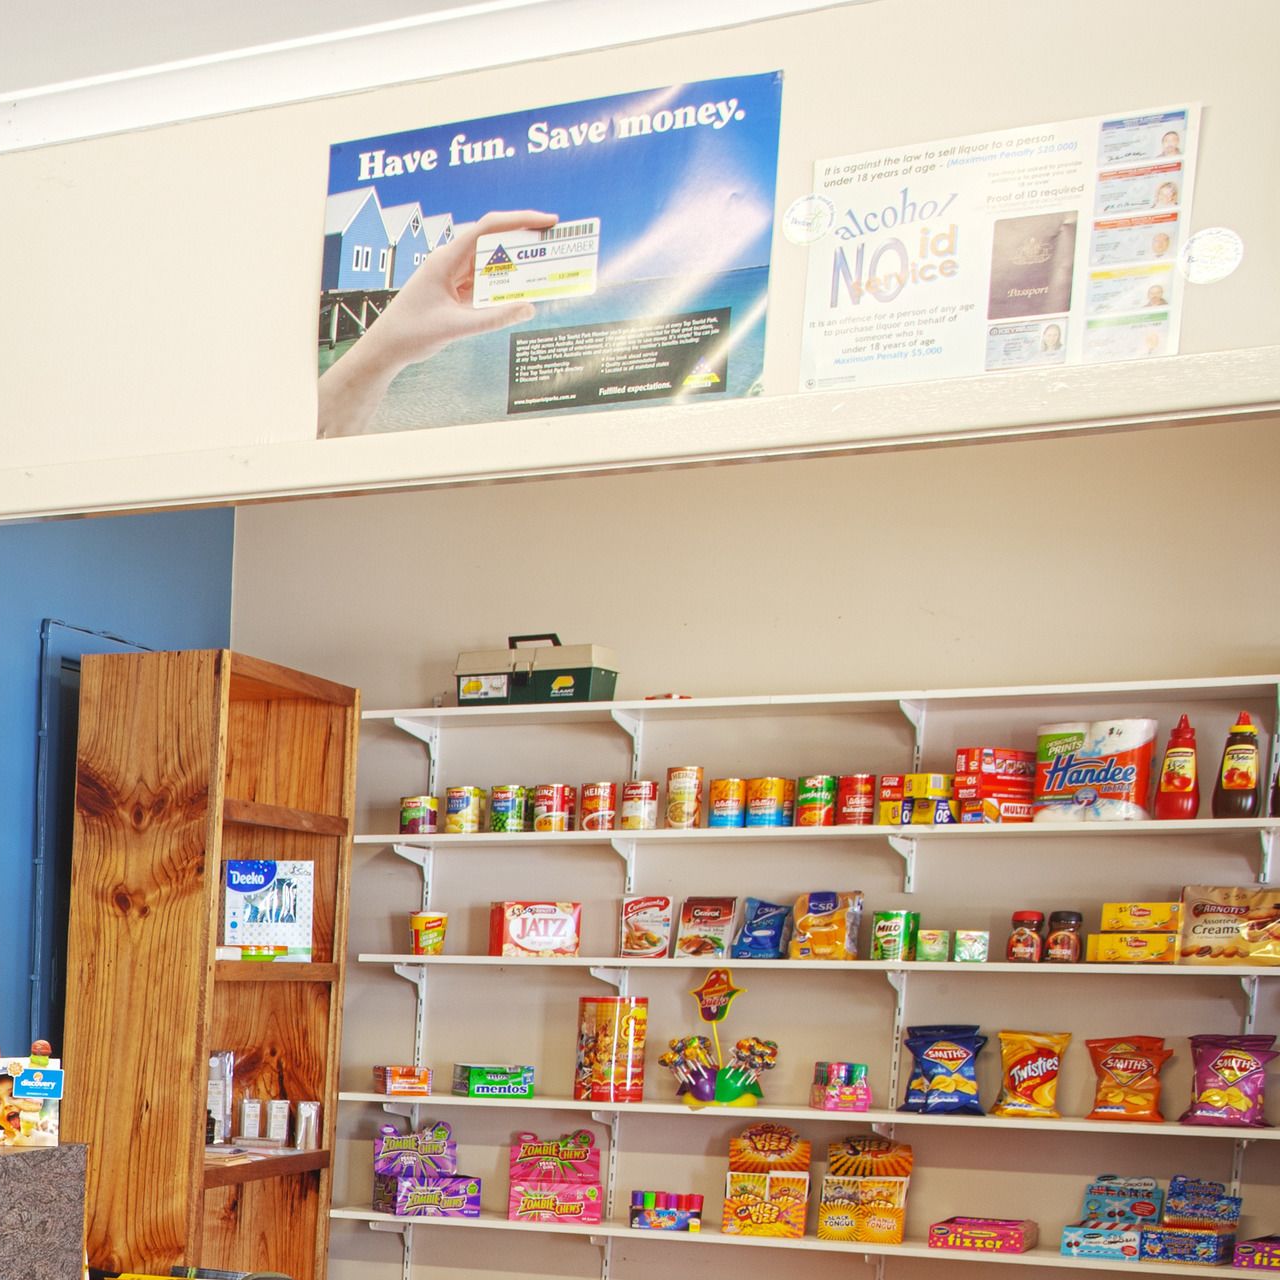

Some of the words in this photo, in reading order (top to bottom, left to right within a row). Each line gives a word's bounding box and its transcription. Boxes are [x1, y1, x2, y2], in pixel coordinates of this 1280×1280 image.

[359, 146, 438, 180] Have
[449, 136, 515, 166] fun.
[527, 116, 605, 154] Save
[616, 98, 745, 138] money.
[843, 161, 881, 175] against
[884, 156, 901, 167] the
[903, 152, 921, 163] law
[924, 150, 935, 160] to
[938, 146, 955, 158] sell
[958, 141, 989, 157] liquor
[992, 139, 1002, 149] to
[1017, 132, 1055, 147] person
[824, 175, 853, 188] under
[857, 173, 868, 183] 18
[870, 169, 898, 185] years
[902, 166, 913, 176] of
[915, 162, 936, 176] age
[947, 153, 995, 168] (Maximum
[987, 191, 1011, 203] Proof
[1027, 190, 1038, 198] ID
[1040, 184, 1084, 197] required
[834, 187, 959, 241] alcohol
[517, 248, 546, 259] CLUB
[551, 240, 594, 255] MEMBER
[920, 223, 958, 260] id
[830, 237, 909, 308] NO
[852, 258, 959, 297] service
[839, 314, 871, 325] offence
[874, 312, 887, 321] for
[897, 309, 926, 323] person
[929, 306, 938, 314] of
[940, 305, 956, 313] any
[959, 303, 975, 312] age
[835, 324, 874, 339] purchase
[876, 321, 900, 332] liquor
[917, 315, 945, 325] behalf
[948, 314, 957, 322] of
[855, 333, 893, 343] someone
[895, 330, 914, 338] who
[841, 344, 867, 354] under
[870, 343, 880, 351] 18
[882, 341, 906, 351] years
[908, 339, 917, 347] of
[919, 338, 935, 347] age
[599, 386, 626, 396] Fulfilled
[628, 382, 672, 393] expectations.
[1048, 741, 1082, 756] PRINTS
[1044, 755, 1136, 790] Handee
[584, 787, 610, 797] HEINZ
[230, 870, 264, 885] Deeko
[809, 902, 834, 911] CSR
[517, 917, 568, 940] JATZ
[877, 924, 901, 933] MILO
[1192, 923, 1240, 935] Creams
[1202, 917, 1238, 926] Assorted
[928, 1049, 967, 1059] SMITH'S
[1010, 1056, 1059, 1086] Twisties
[1106, 1058, 1149, 1070] SMITH'S
[20, 1079, 56, 1089] discovery
[476, 1084, 528, 1095] mentos
[383, 1137, 419, 1153] ZOMBIE
[418, 1143, 447, 1155] CHEWS
[520, 1143, 558, 1160] ZOMBIE
[558, 1149, 588, 1161] CHEWS
[407, 1192, 442, 1208] ZOMBIE
[440, 1197, 466, 1208] CHEWS
[519, 1198, 556, 1214] ZOMBIE
[556, 1203, 584, 1215] CHEWS
[865, 1221, 897, 1230] TONGUE
[947, 1233, 1003, 1250] fizzer
